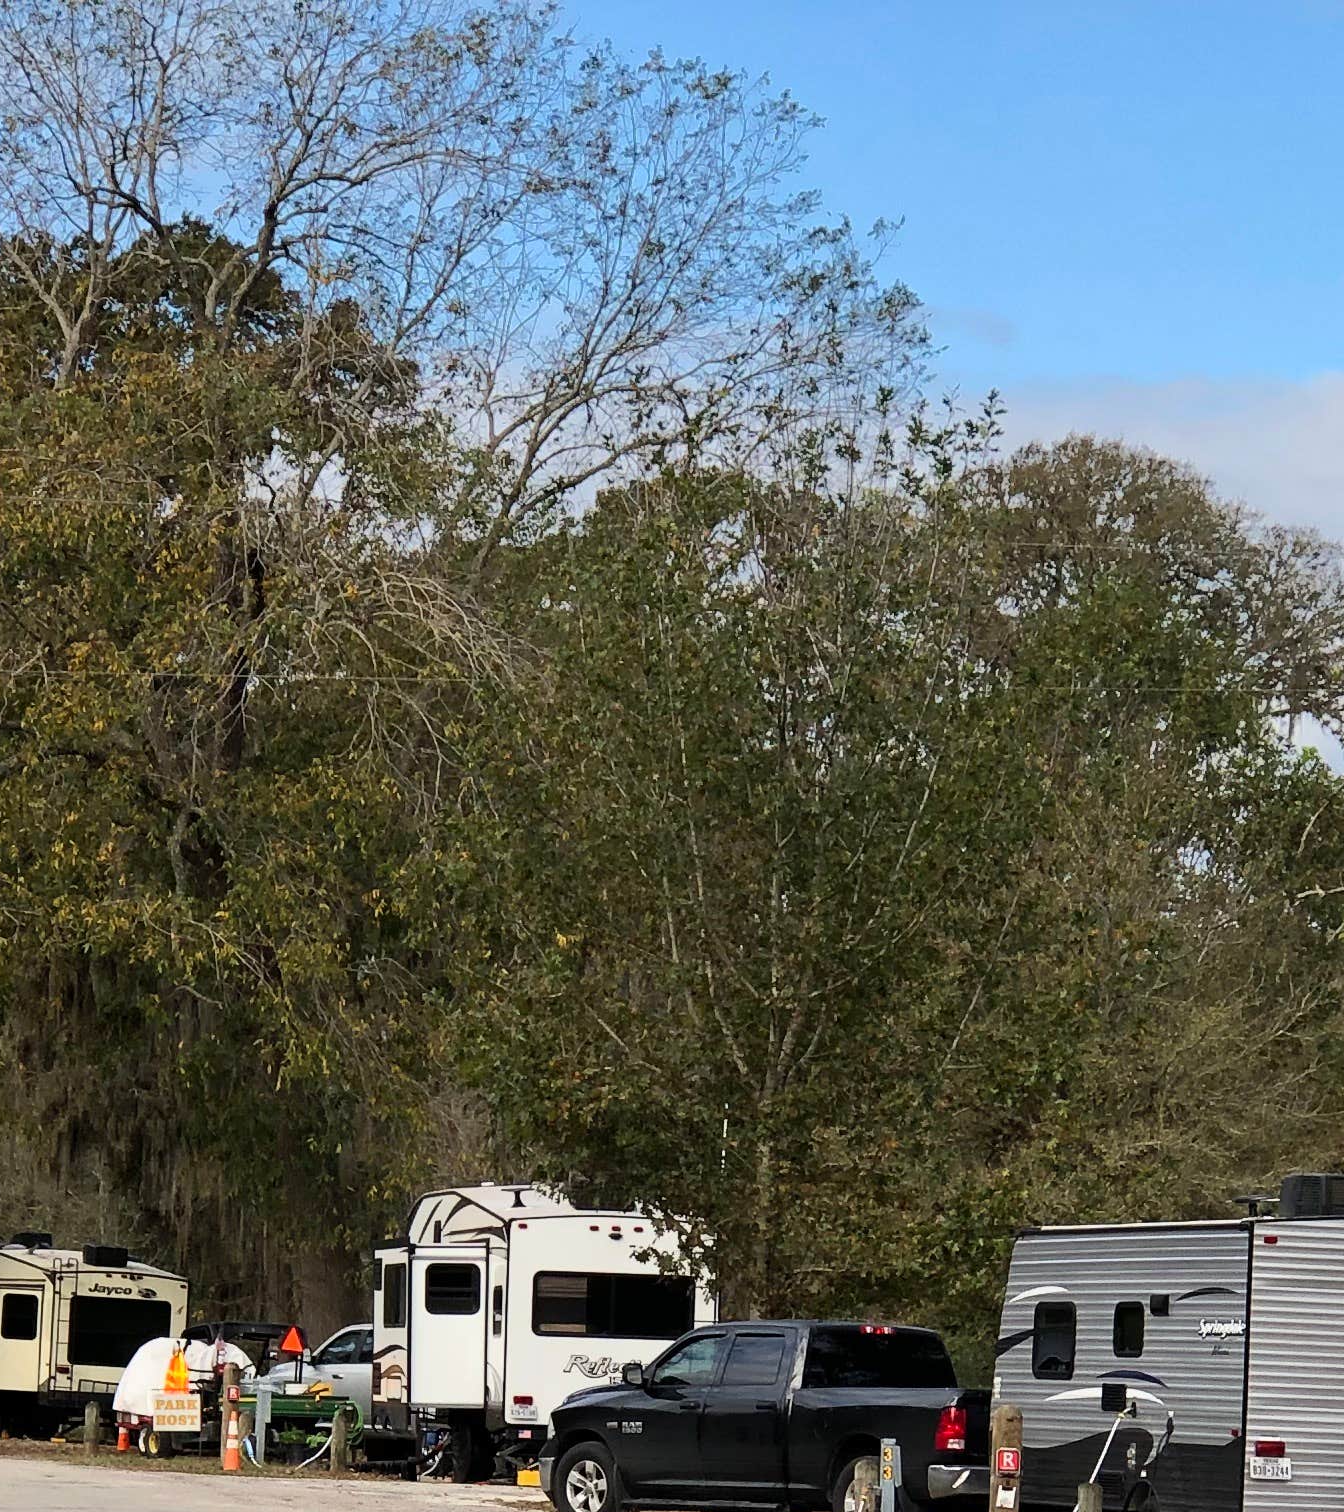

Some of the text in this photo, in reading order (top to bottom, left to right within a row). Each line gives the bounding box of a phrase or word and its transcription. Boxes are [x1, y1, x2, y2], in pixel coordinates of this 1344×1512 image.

[88, 1283, 133, 1296] Jayco
[563, 1355, 649, 1379] Reflec
[155, 1400, 198, 1410] PARK
[156, 1414, 198, 1425] HOST
[1003, 1451, 1015, 1467] R
